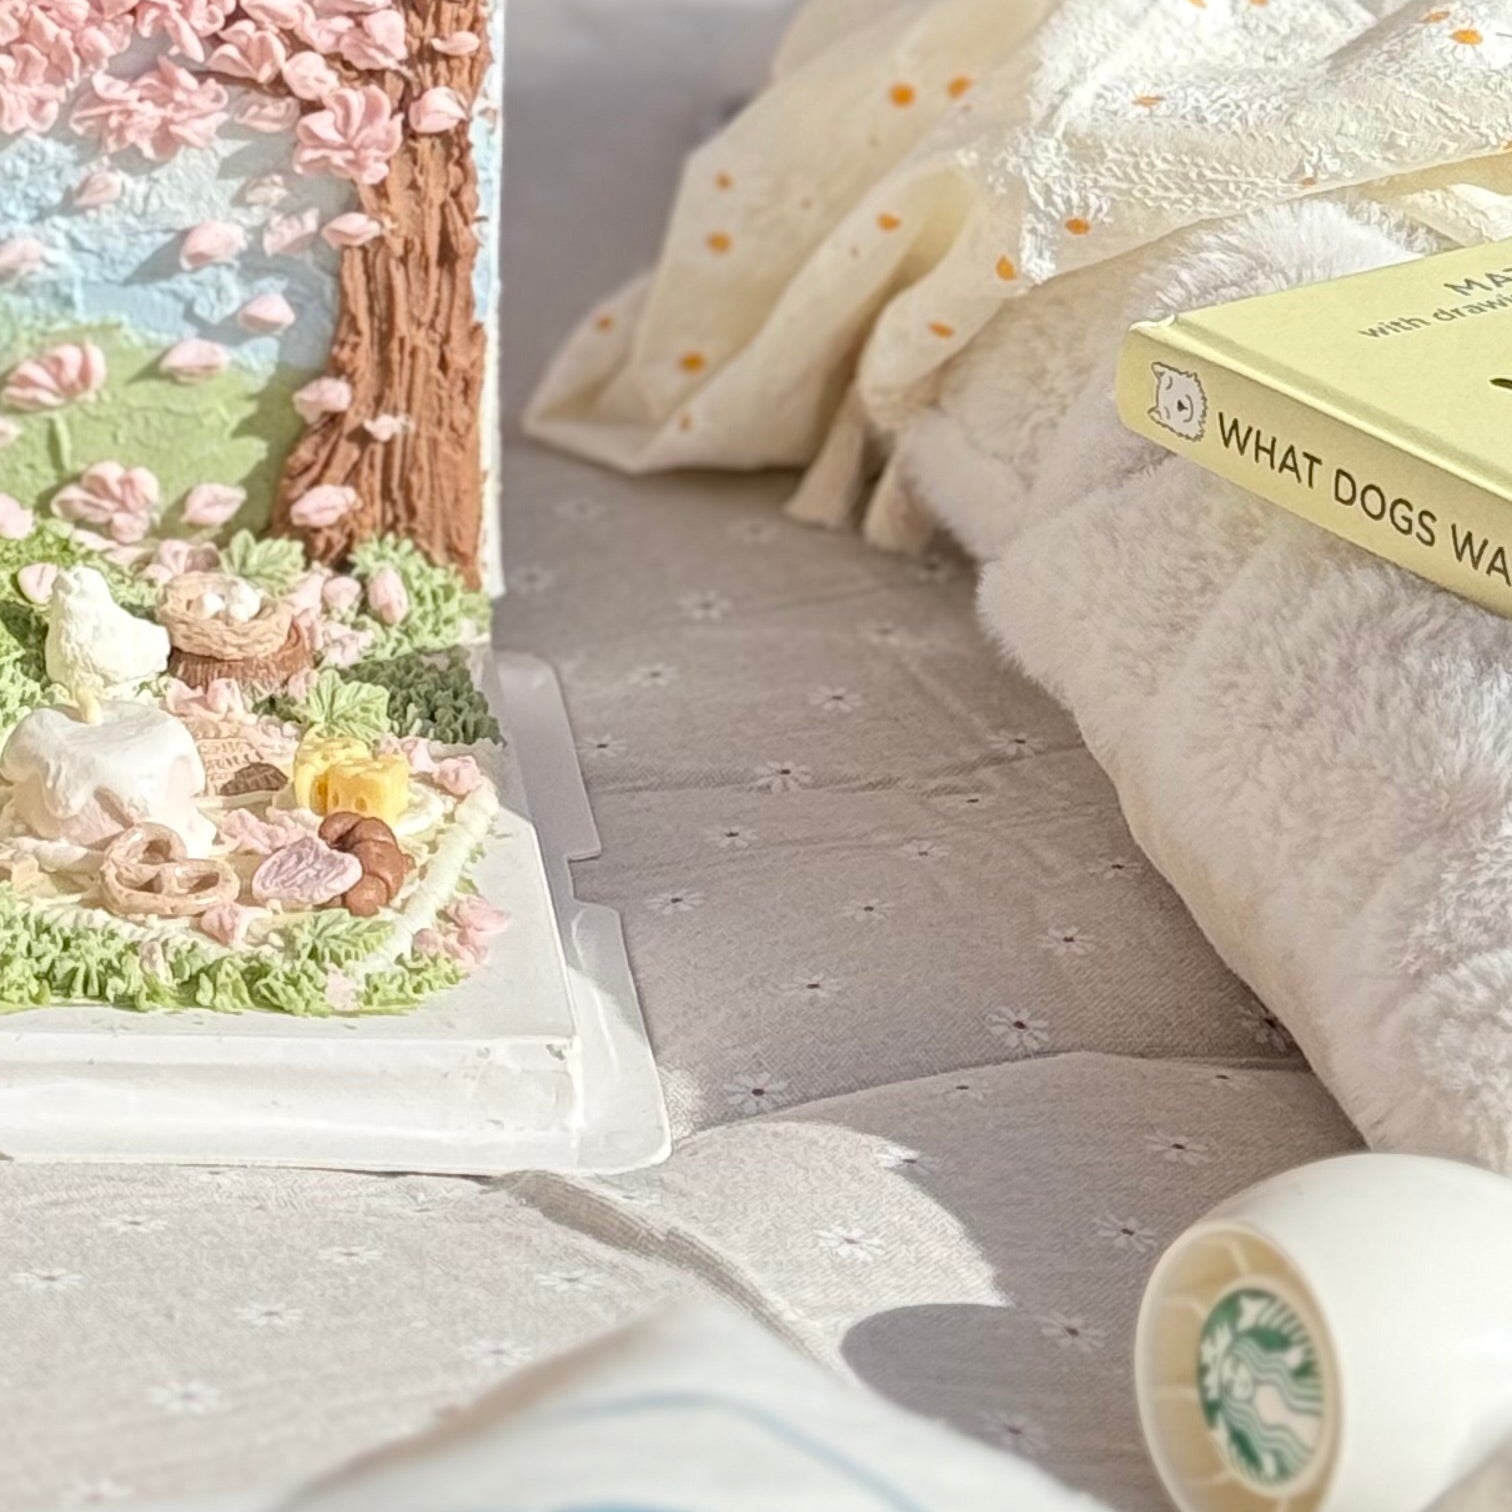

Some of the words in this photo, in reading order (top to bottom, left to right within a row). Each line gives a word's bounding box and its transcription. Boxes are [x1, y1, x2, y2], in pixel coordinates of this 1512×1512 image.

[1358, 316, 1431, 338] with
[1432, 293, 1512, 322] drawi
[1218, 412, 1322, 489] WHAT
[1334, 468, 1437, 547] DOGS
